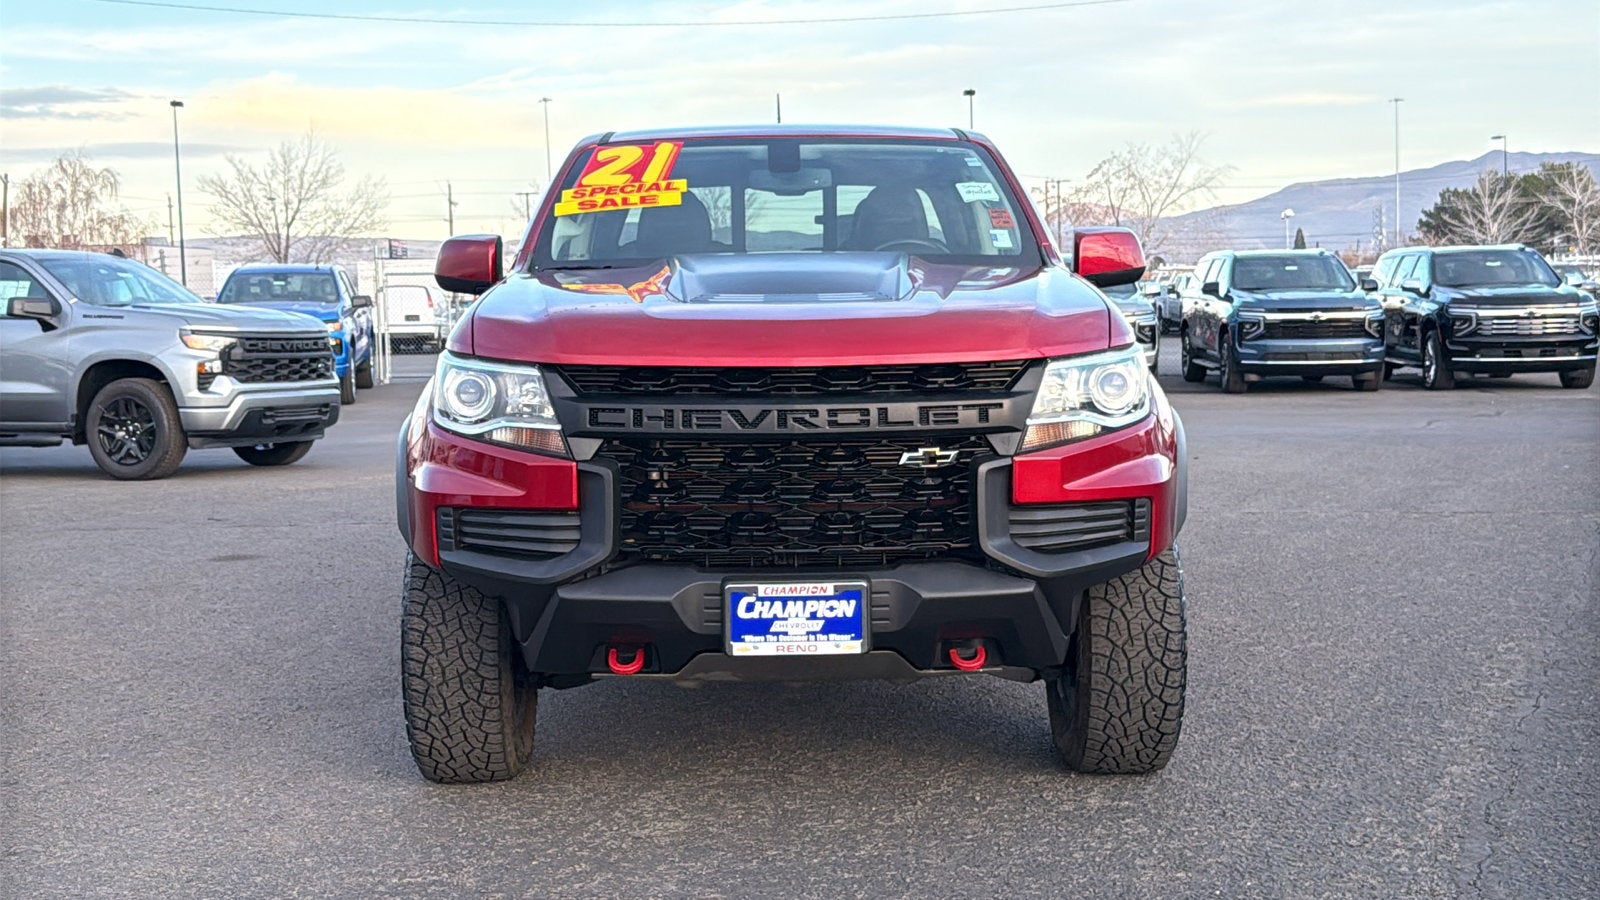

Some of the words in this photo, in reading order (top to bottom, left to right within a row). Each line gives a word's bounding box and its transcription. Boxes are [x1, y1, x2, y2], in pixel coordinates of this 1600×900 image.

[581, 142, 676, 186] 21
[571, 182, 681, 199] SPECIAL
[577, 194, 660, 211] SALE
[587, 402, 1004, 431] CHEVROLET
[763, 586, 828, 596] CHAMPION
[776, 644, 818, 653] RENO
